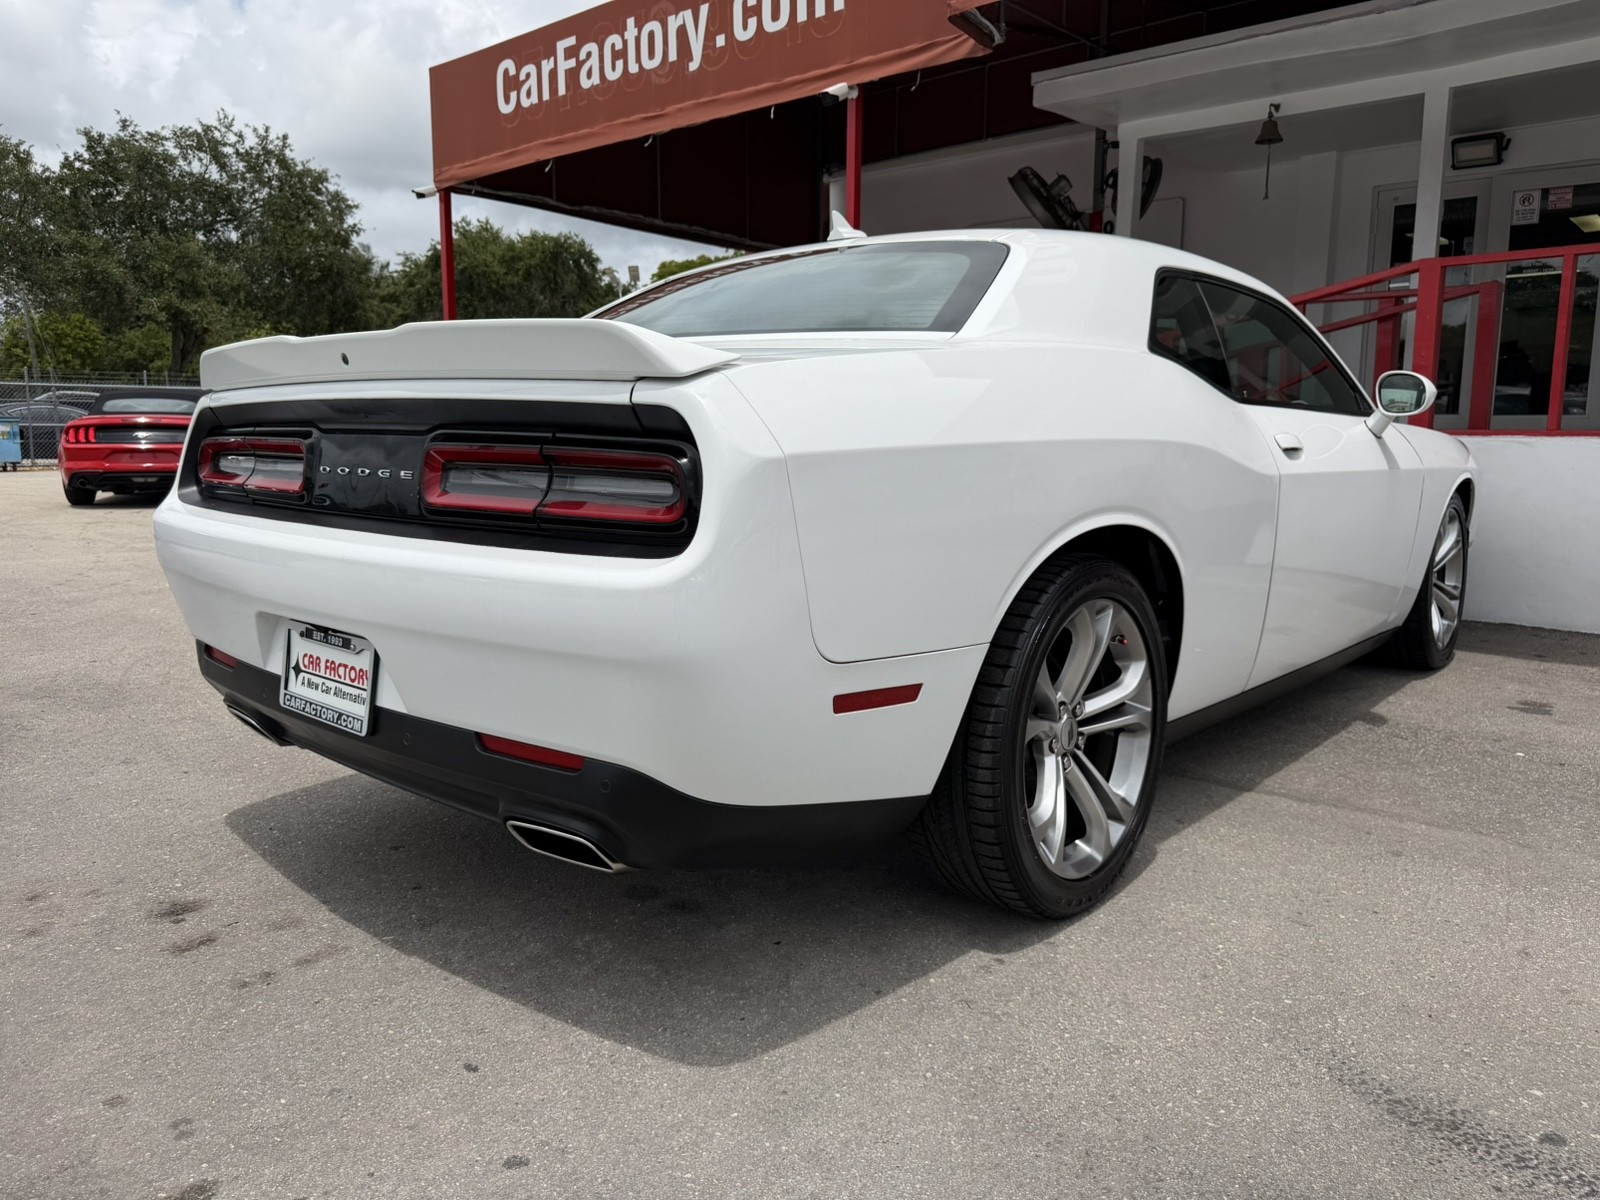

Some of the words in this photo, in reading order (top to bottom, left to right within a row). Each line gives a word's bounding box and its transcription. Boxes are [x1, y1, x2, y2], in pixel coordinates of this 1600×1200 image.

[320, 466, 413, 480] DODGE
[313, 631, 326, 642] EST.
[302, 653, 321, 673] CAR
[301, 676, 306, 687] A
[306, 678, 320, 691] New
[321, 682, 332, 694] Car
[285, 695, 361, 731] CARFACTORY.COM
